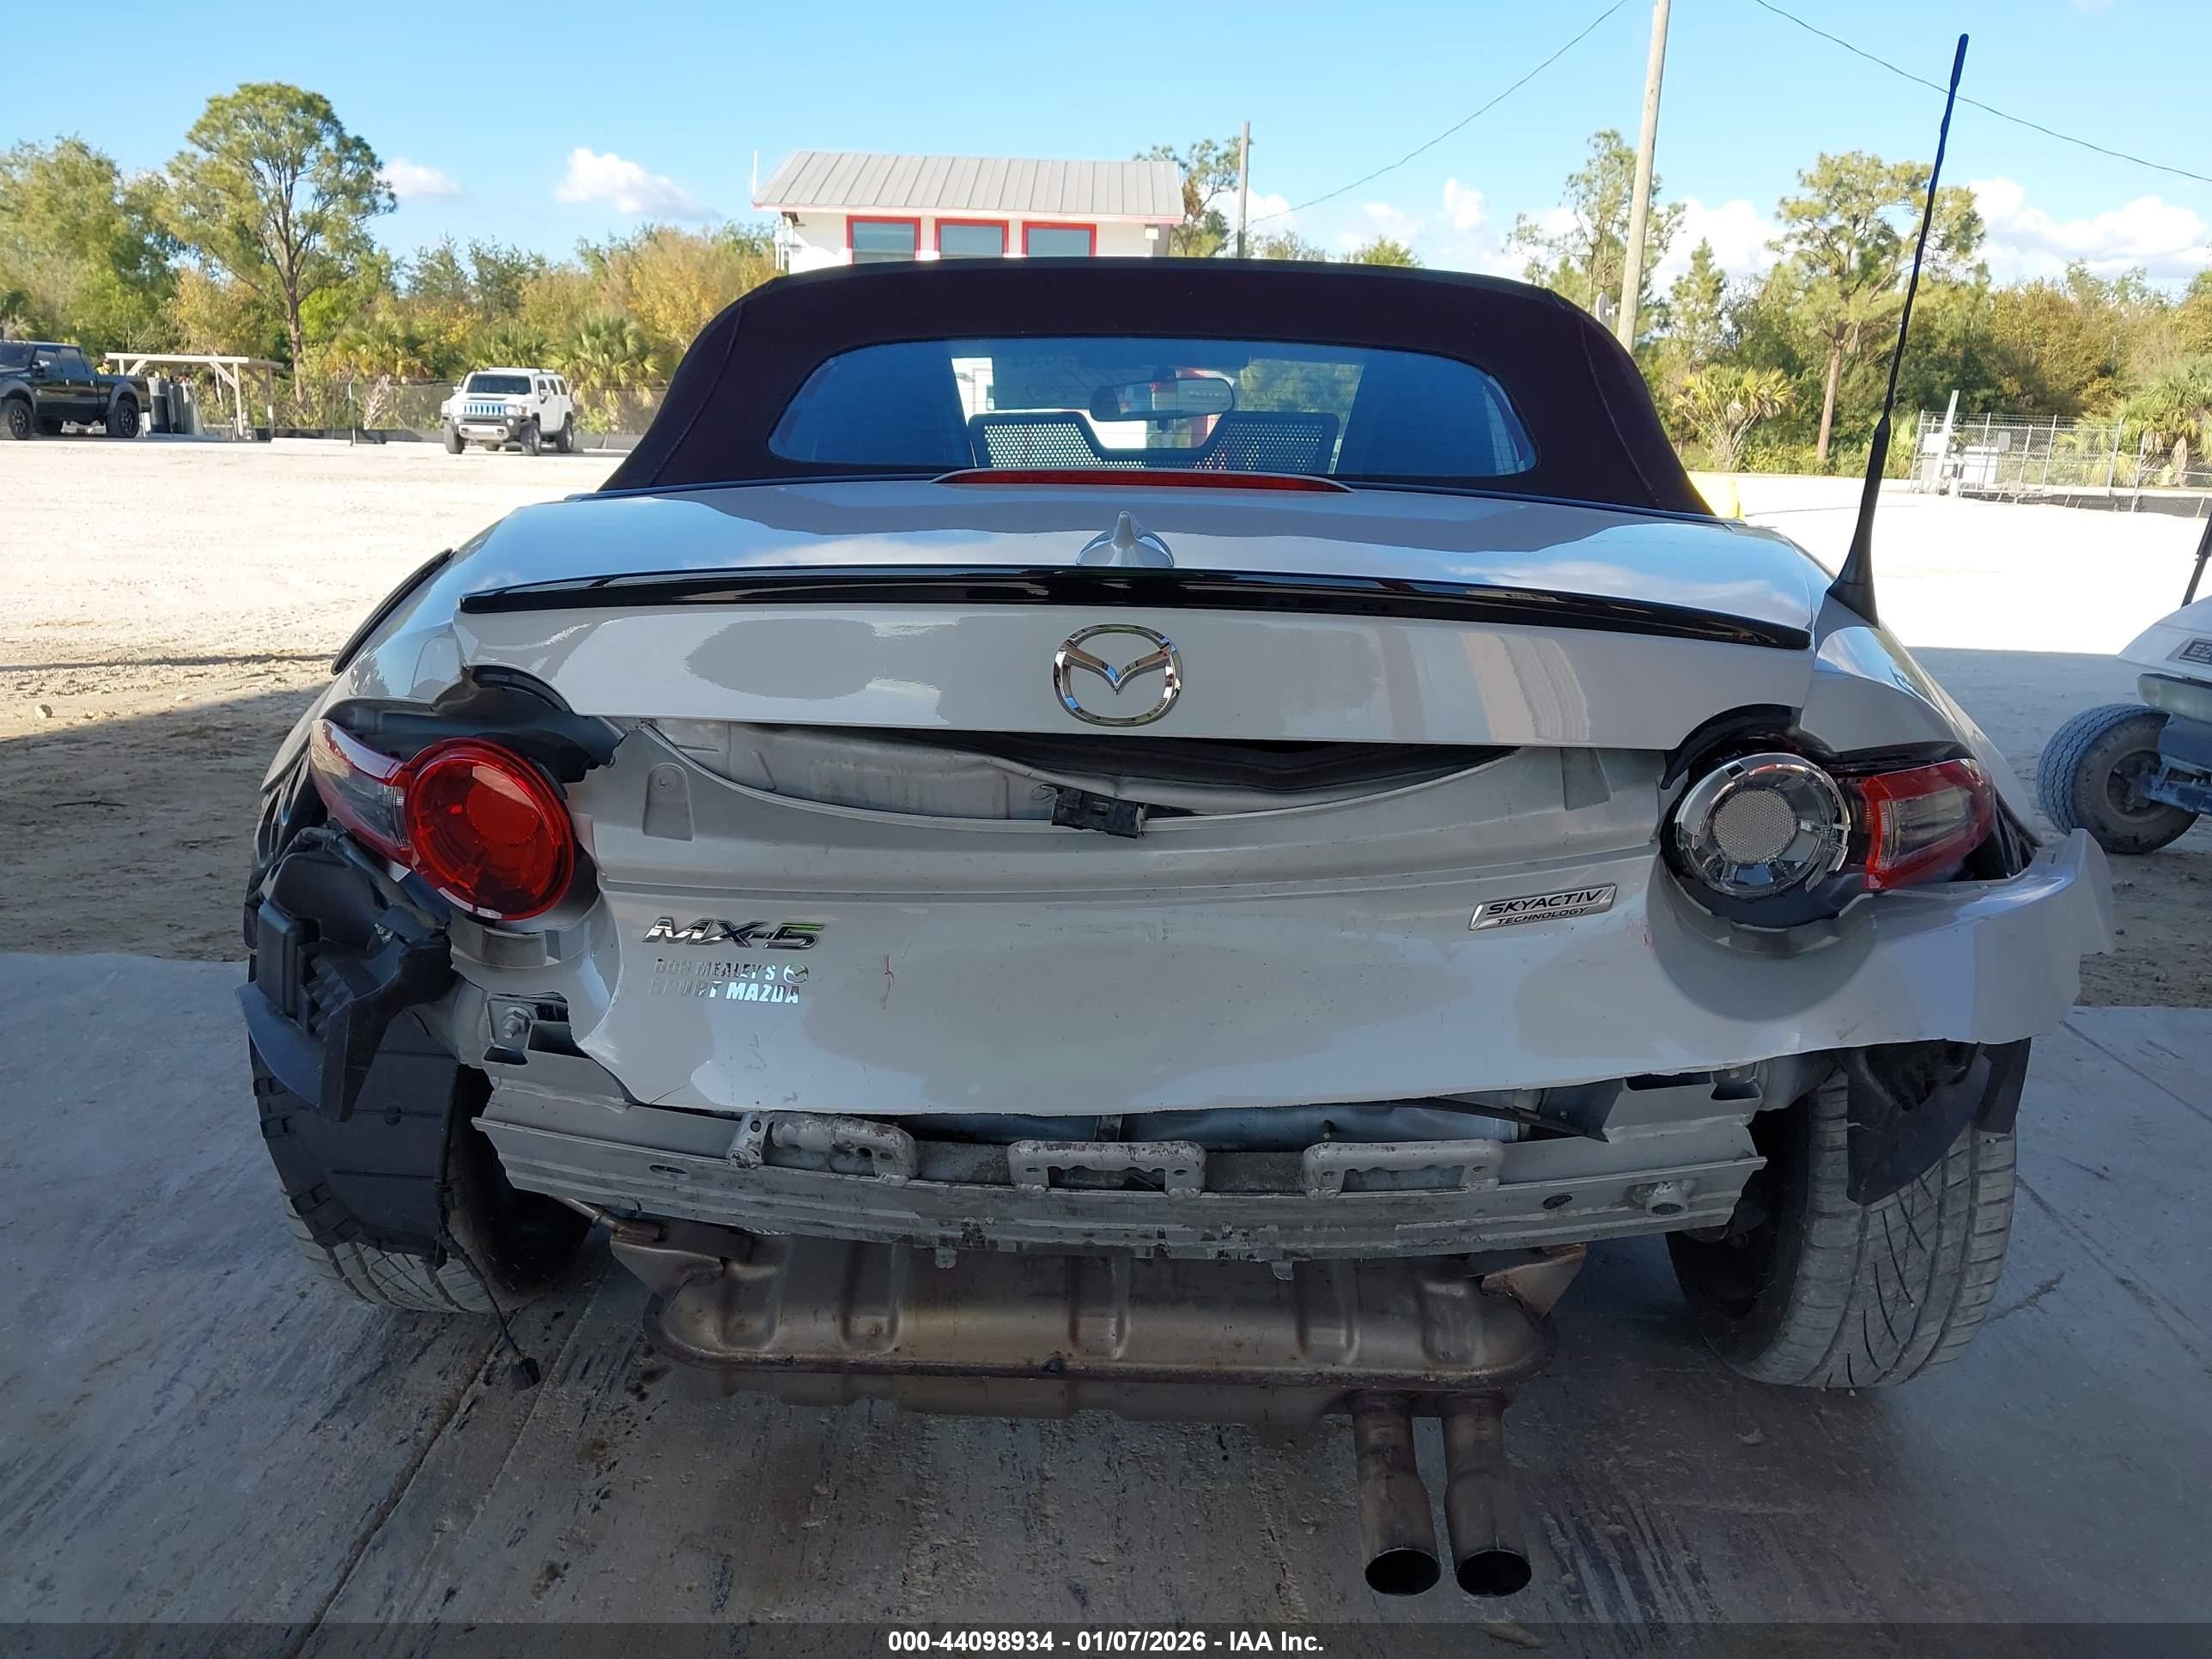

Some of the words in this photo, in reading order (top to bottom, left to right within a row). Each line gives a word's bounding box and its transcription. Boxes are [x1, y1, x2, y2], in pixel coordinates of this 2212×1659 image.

[1486, 890, 1602, 915] SKYACTIV
[1497, 907, 1589, 925] TECHNOLOGY
[642, 915, 825, 949] MX-5
[725, 981, 799, 1004] MAZDA
